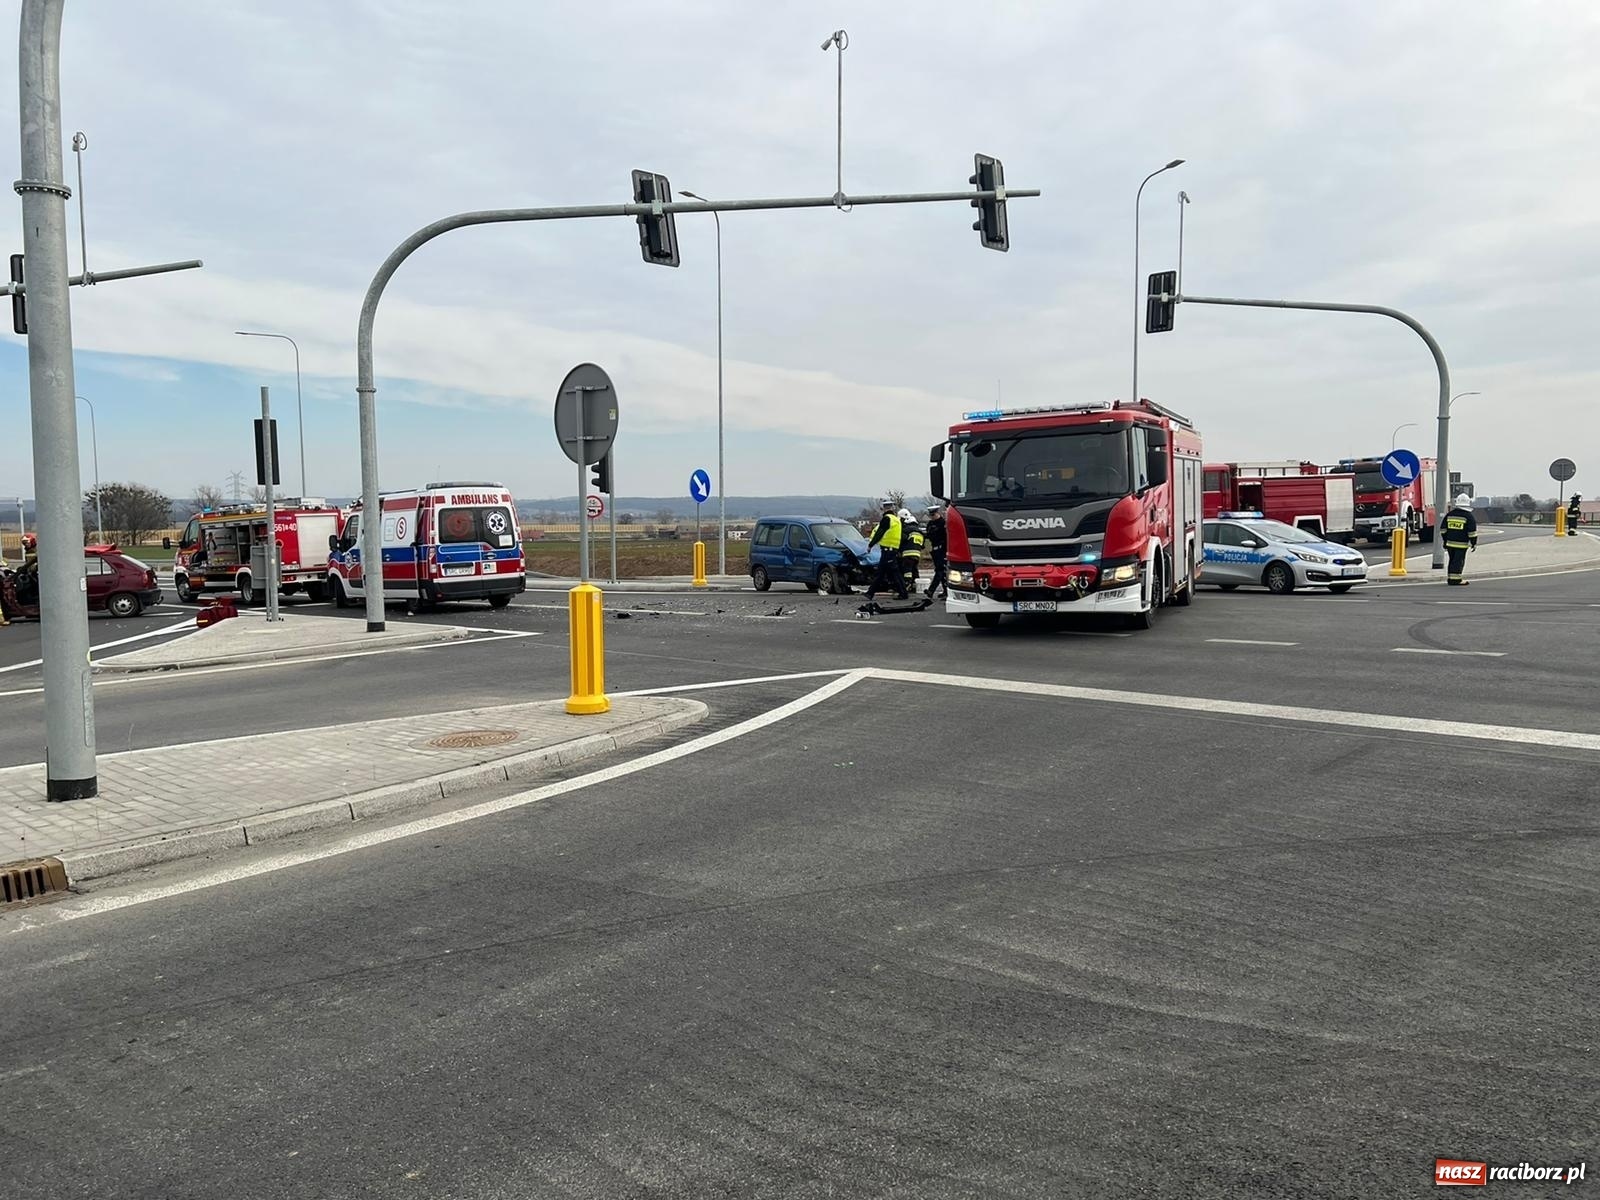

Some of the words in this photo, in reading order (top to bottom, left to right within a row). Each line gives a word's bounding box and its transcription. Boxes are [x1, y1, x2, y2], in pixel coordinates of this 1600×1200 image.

[451, 494, 499, 505] AMBULANS
[1002, 517, 1066, 530] SCANIA
[1223, 553, 1248, 561] POLICJA
[1018, 602, 1034, 610] SRC
[1035, 602, 1055, 610] MN02
